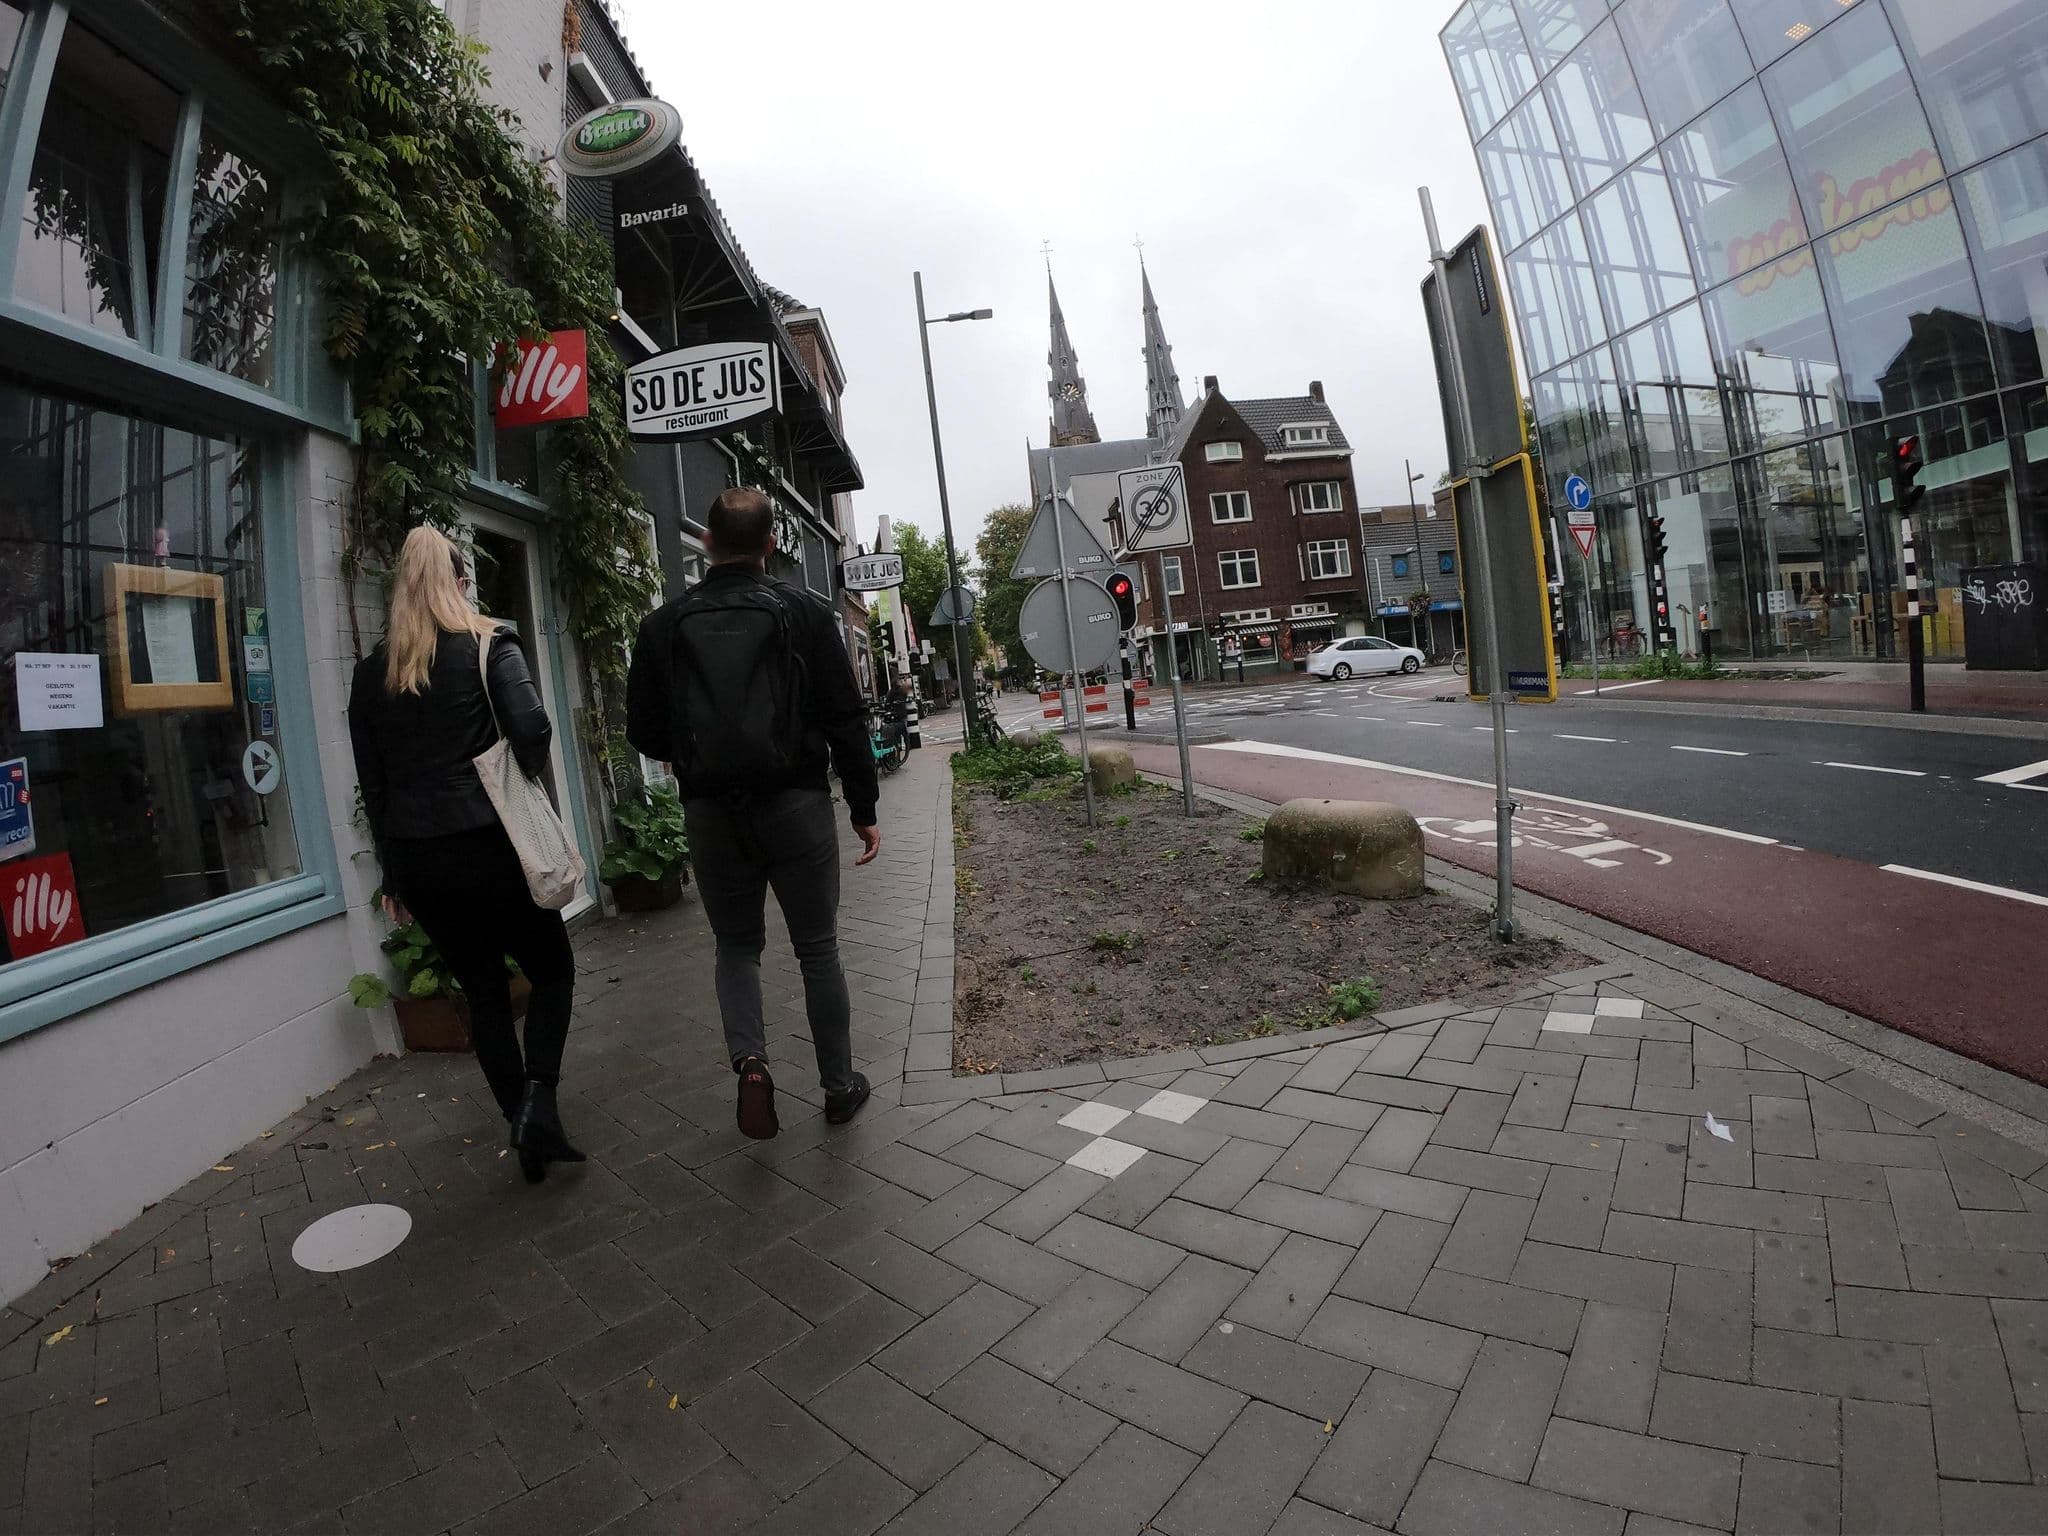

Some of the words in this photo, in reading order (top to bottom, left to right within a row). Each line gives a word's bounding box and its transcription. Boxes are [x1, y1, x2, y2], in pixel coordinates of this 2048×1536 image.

[580, 112, 647, 145] Brand
[620, 203, 689, 228] Bavaria
[631, 375, 666, 415] SO
[672, 366, 707, 408] DE
[712, 356, 766, 400] JUS
[665, 407, 729, 431] restaurant
[1135, 472, 1165, 483] ZONE
[863, 563, 877, 580] DE
[880, 560, 900, 577] JUS
[1078, 555, 1102, 564] BUKO
[1088, 612, 1112, 624] BUKO
[13, 872, 72, 942] illy
